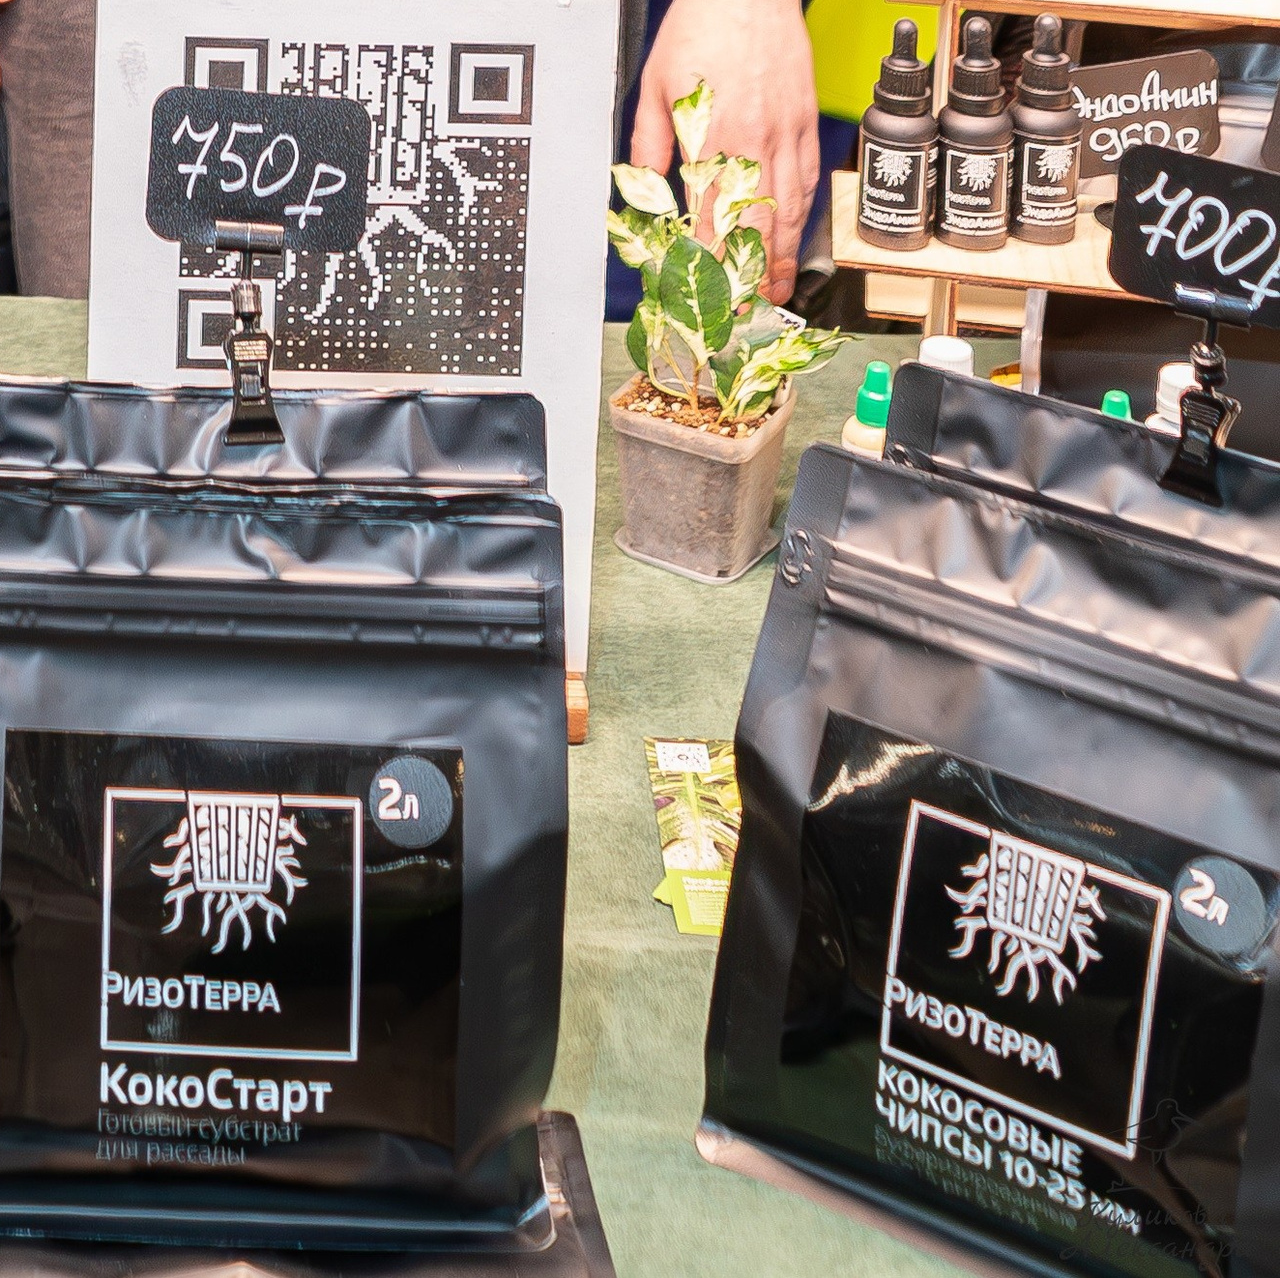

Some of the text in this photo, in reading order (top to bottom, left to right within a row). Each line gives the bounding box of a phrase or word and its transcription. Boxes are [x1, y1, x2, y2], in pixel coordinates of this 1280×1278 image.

[377, 776, 420, 822] 2л
[1178, 866, 1230, 927] 2л
[99, 1061, 333, 1122] КокоСтарт
[877, 1058, 1084, 1177] КОКОСОВЫЕ
[874, 1091, 992, 1172] ЧИПСЫ
[998, 1148, 1087, 1212] 10-25
